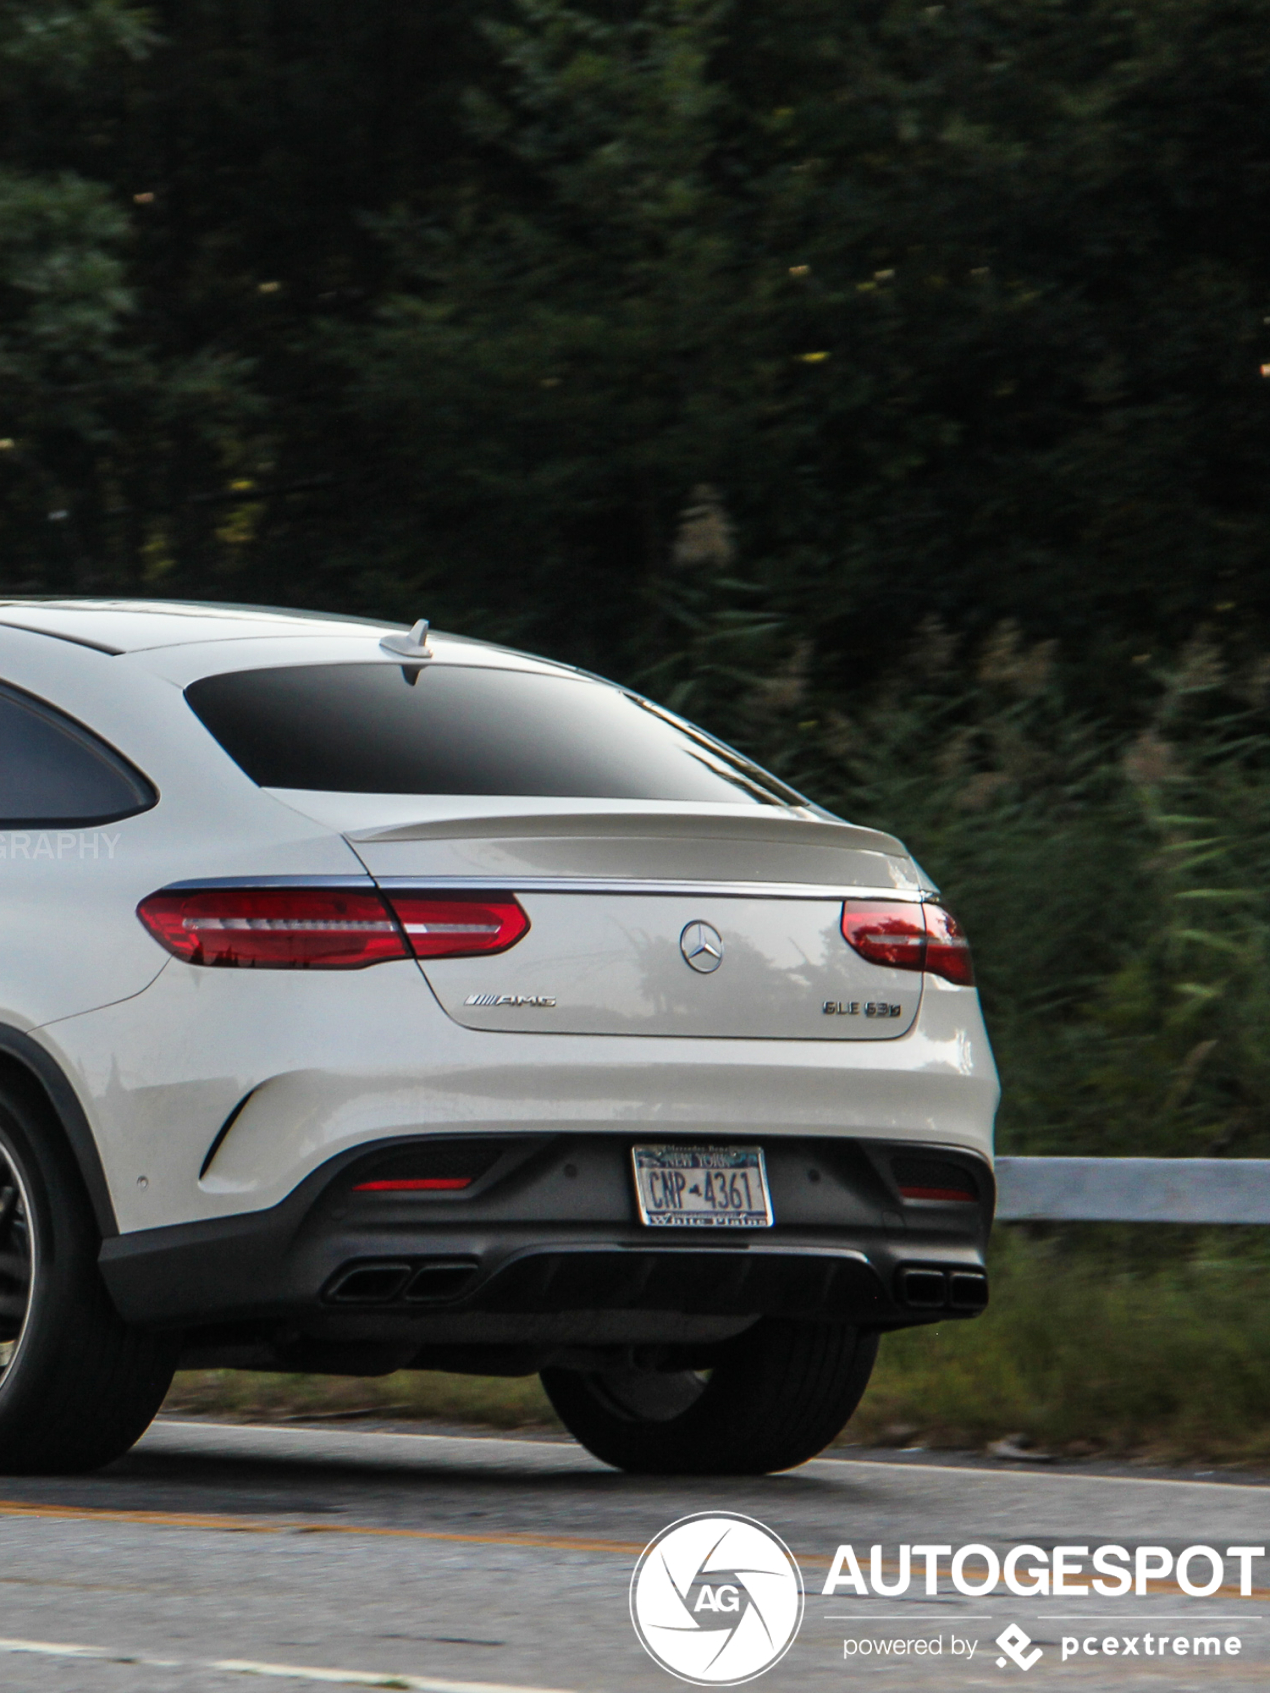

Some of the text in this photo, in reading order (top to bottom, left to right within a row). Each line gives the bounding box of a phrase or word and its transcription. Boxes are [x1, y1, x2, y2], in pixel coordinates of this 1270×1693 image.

[823, 1001, 860, 1015] GLE
[665, 1153, 731, 1168] NEW YORK
[649, 1171, 753, 1210] CNP 4361
